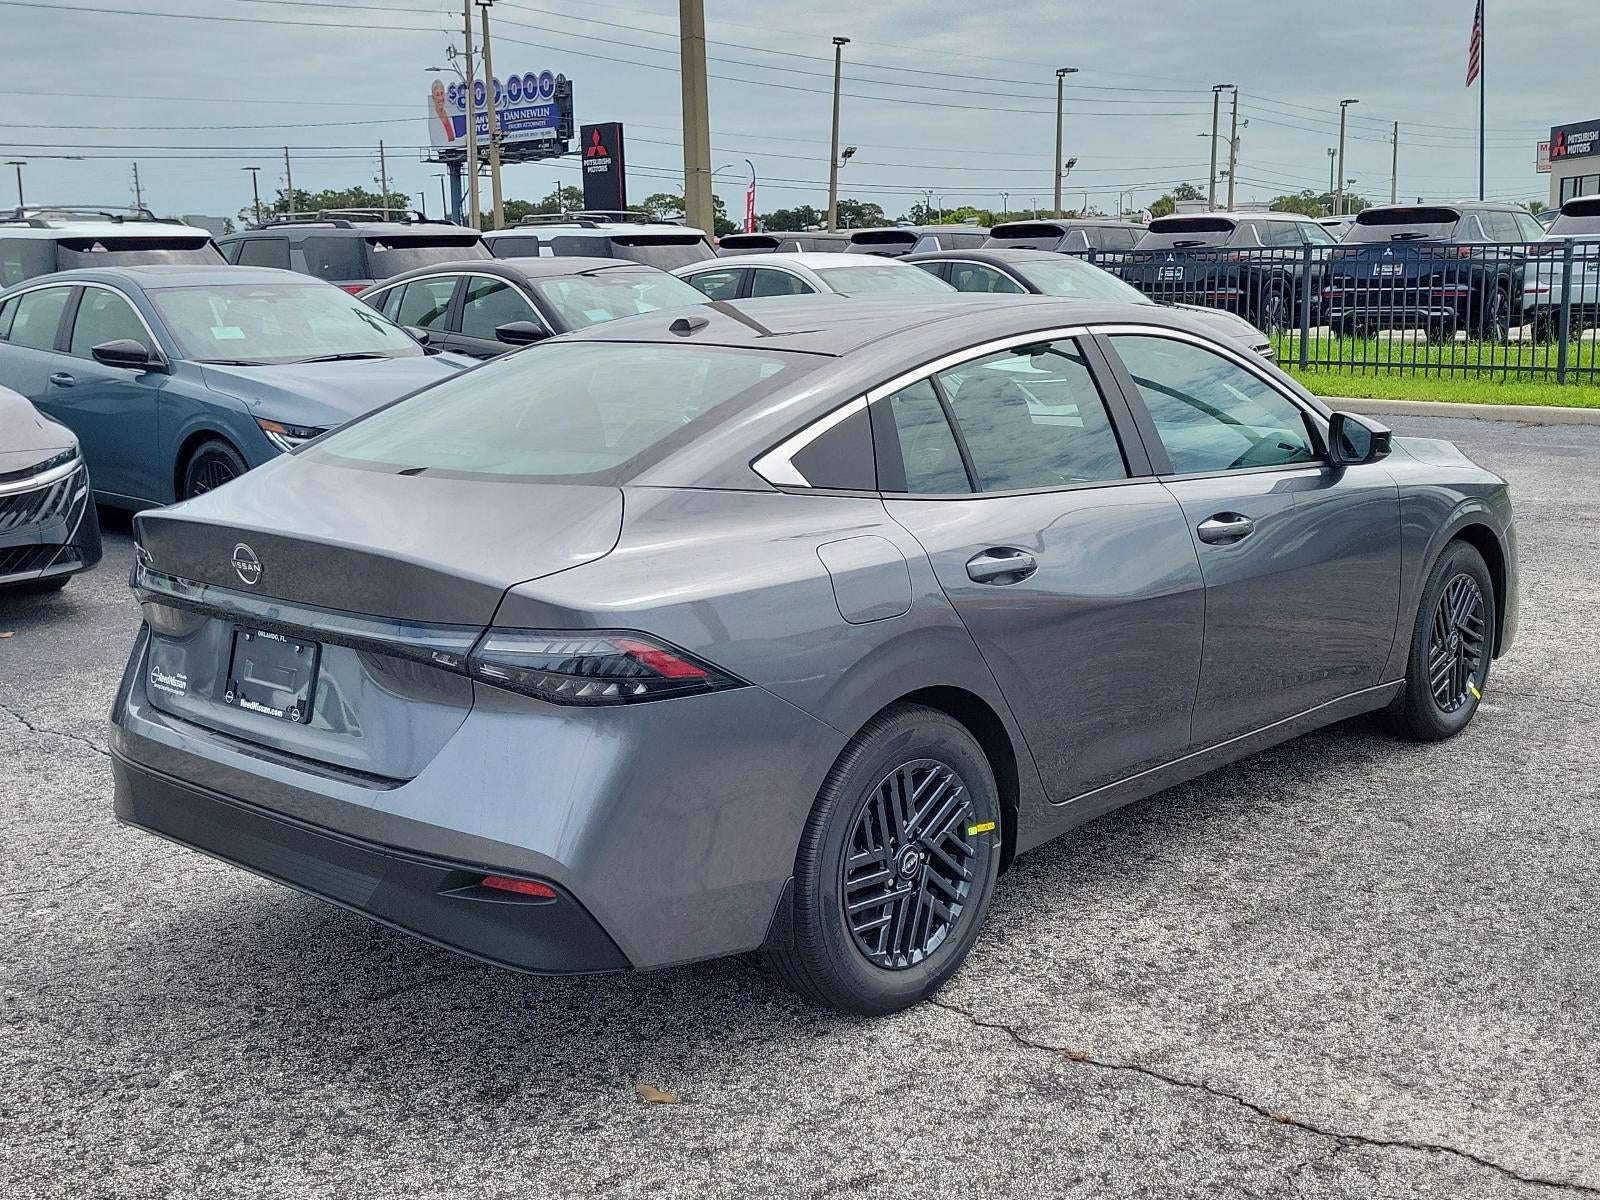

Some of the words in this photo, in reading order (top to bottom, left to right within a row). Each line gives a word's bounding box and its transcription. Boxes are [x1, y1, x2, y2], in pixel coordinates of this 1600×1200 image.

[503, 110, 520, 121] DAN
[520, 107, 550, 118] NEWLIN
[1567, 131, 1599, 144] MITSUBISHI
[1567, 143, 1591, 154] MOTORS
[583, 158, 612, 166] MITSUBISHI
[587, 165, 608, 173] MOTORS
[240, 698, 283, 718] ReedNissan.com
